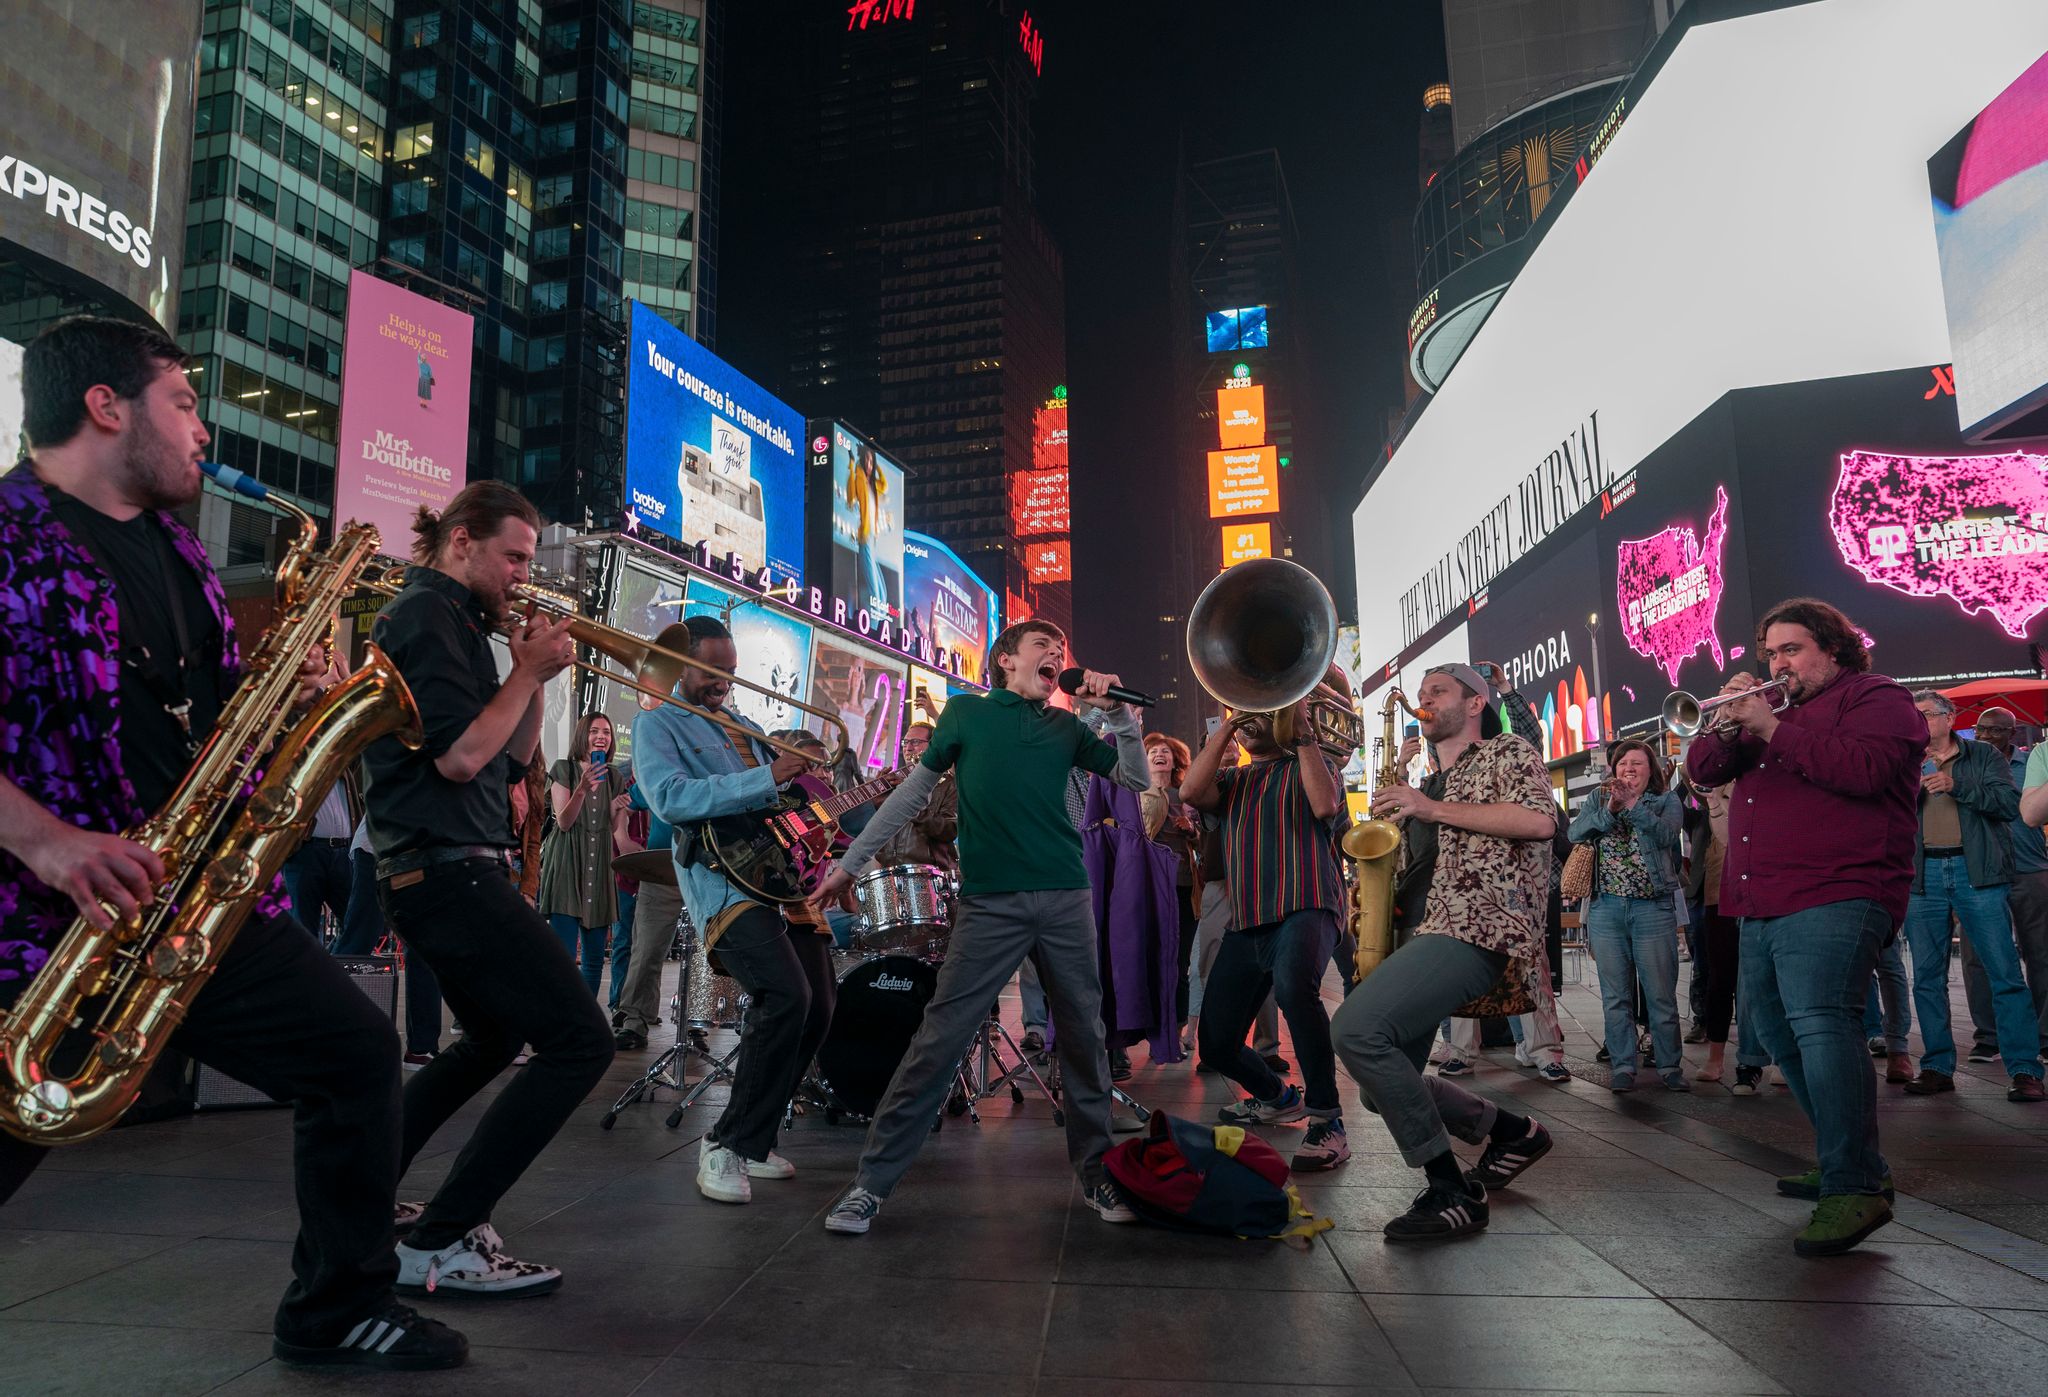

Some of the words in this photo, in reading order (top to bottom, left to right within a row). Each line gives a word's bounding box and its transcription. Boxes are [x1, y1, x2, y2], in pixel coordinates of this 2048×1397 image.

[848, 0, 915, 31] H&M
[1019, 9, 1043, 78] H&M
[1590, 96, 1625, 155] MARRIOTT
[1411, 288, 1439, 330] MARRIOTT
[389, 313, 416, 335] Help
[417, 324, 427, 338] is
[427, 331, 442, 343] on
[1411, 307, 1436, 344] MARQUIS
[379, 325, 397, 340] the
[399, 332, 422, 350] way,
[423, 340, 449, 359] dear.
[1225, 377, 1252, 389] 2021
[647, 339, 676, 379] Your
[676, 367, 724, 411] courage
[725, 392, 735, 418] is
[736, 404, 795, 456] remarkable.
[375, 429, 414, 453] Mrs.
[717, 429, 746, 458] Thank
[843, 436, 851, 451] LG
[362, 440, 452, 482] Doubtfire
[723, 455, 743, 474] you
[813, 454, 828, 466] LG
[1223, 453, 1261, 465] Womply
[1227, 464, 1259, 476] helped
[365, 474, 397, 490] Previews
[398, 483, 418, 496] begin
[419, 489, 441, 502] March
[1218, 488, 1270, 500] businesses
[1239, 475, 1265, 486] small
[1611, 469, 1637, 496] MARRIOTT
[633, 487, 667, 515] brother
[1612, 484, 1636, 507] MARQUIS
[643, 508, 652, 518] your
[651, 511, 661, 521] side
[1237, 533, 1255, 548] #1
[1399, 582, 1423, 648] THE
[1421, 552, 1457, 629] WALL
[1456, 494, 1513, 603] STREET
[1518, 409, 1615, 555] JOURNAL.
[1914, 515, 2026, 543] LARGEST.
[905, 544, 929, 558] Original
[1915, 539, 1966, 563] THE
[869, 595, 877, 607] LG
[1640, 582, 1674, 612] LARGEST.
[1674, 563, 1709, 595] FASTEST.
[343, 599, 366, 613] TIMES
[702, 540, 797, 604] 1540
[810, 586, 963, 679] BROADWAY
[934, 589, 955, 621] ALL
[1641, 607, 1658, 628] THE
[1656, 590, 1688, 622] LEADER
[1687, 586, 1698, 607] IN
[1697, 580, 1710, 602] 5G
[1496, 630, 1571, 698] EPHORA
[1987, 670, 2014, 678] Experience
[616, 723, 626, 734] Tell
[868, 972, 914, 991] Ludwig
